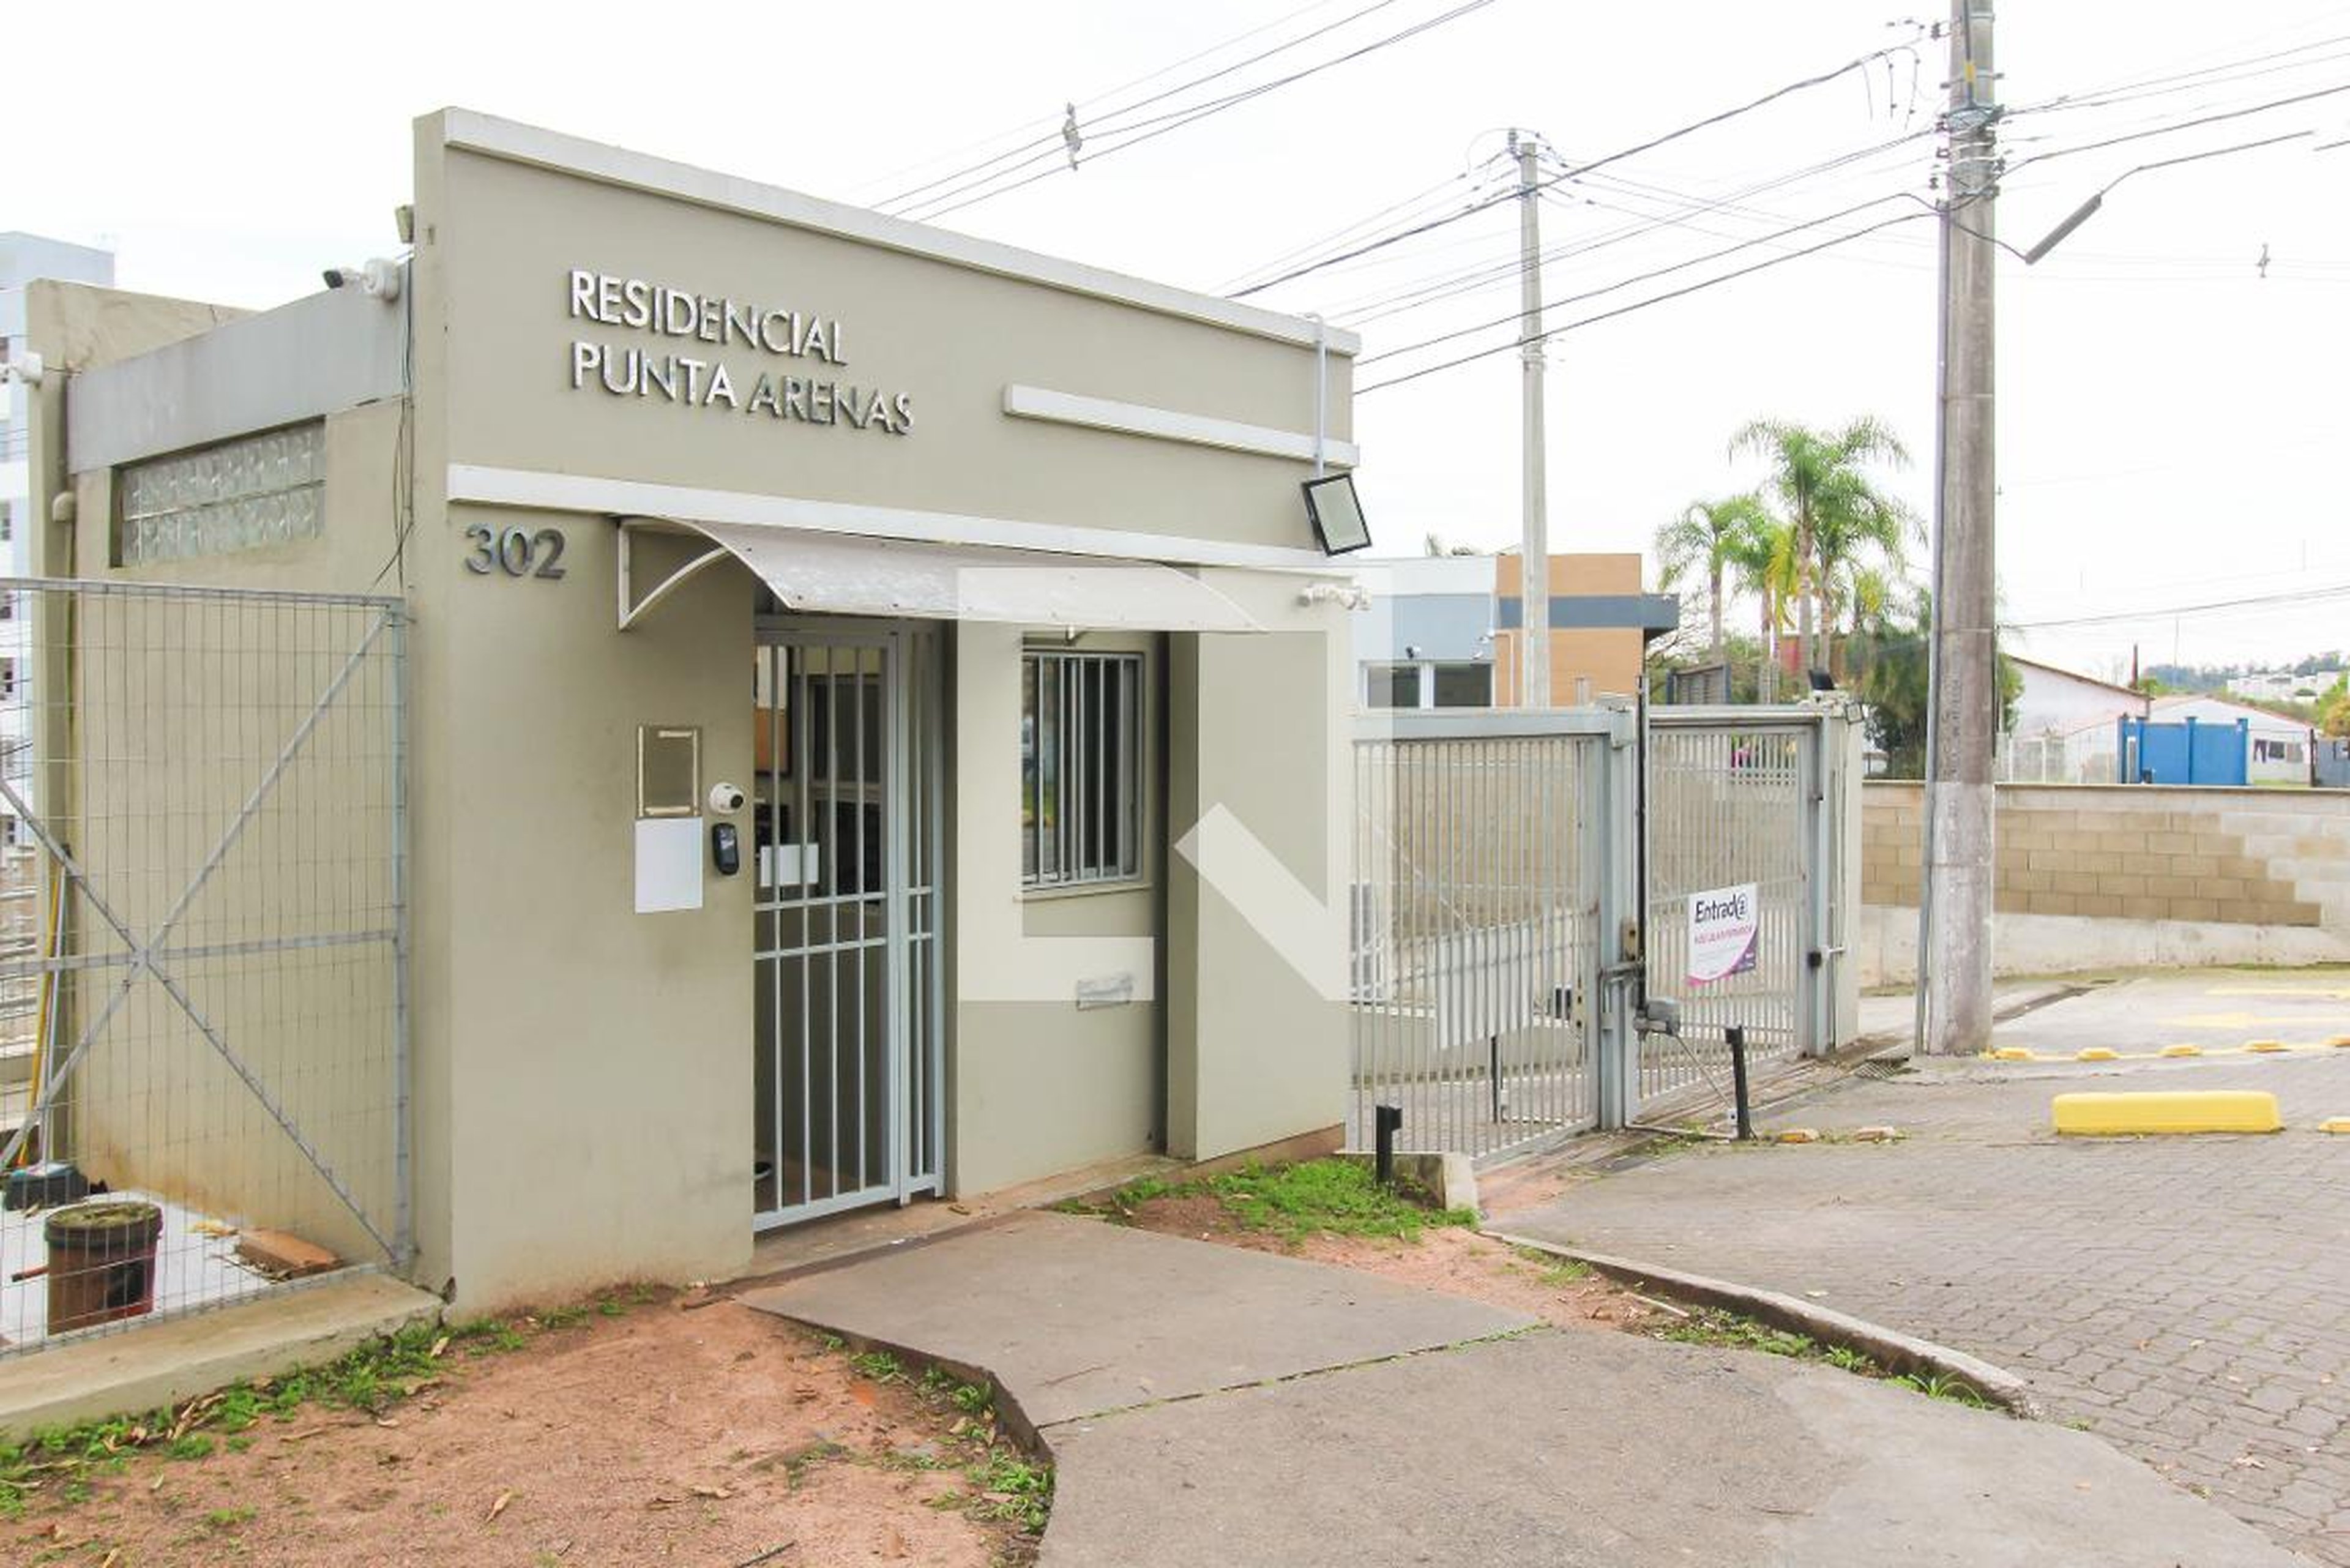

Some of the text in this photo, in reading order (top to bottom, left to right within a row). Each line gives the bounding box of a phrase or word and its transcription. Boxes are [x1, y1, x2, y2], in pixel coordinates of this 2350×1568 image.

[570, 269, 848, 366] RESIDENCIAL
[572, 342, 915, 435] PUNTA ARENAS
[465, 524, 566, 580] 302
